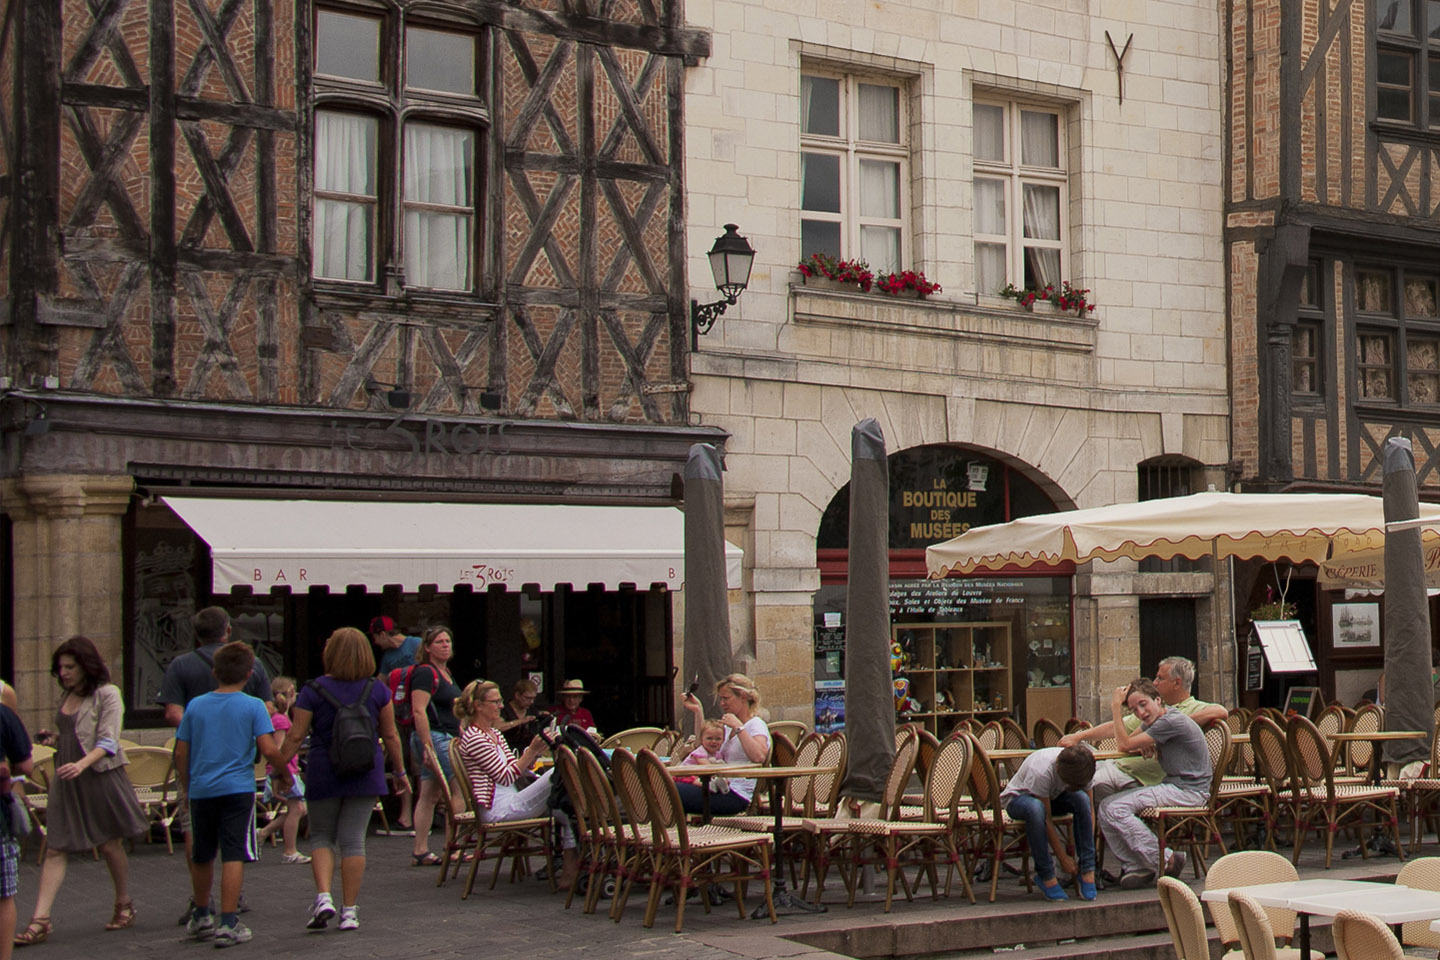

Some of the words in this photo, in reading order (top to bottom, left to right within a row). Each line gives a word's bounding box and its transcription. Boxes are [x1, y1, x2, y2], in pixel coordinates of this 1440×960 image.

[424, 418, 515, 456] ROIS
[933, 478, 947, 489] LA
[903, 491, 977, 508] BOUTIQUE
[930, 510, 951, 520] DES
[253, 568, 308, 581] BAR
[472, 564, 487, 589] 3
[487, 567, 514, 581] ROIS
